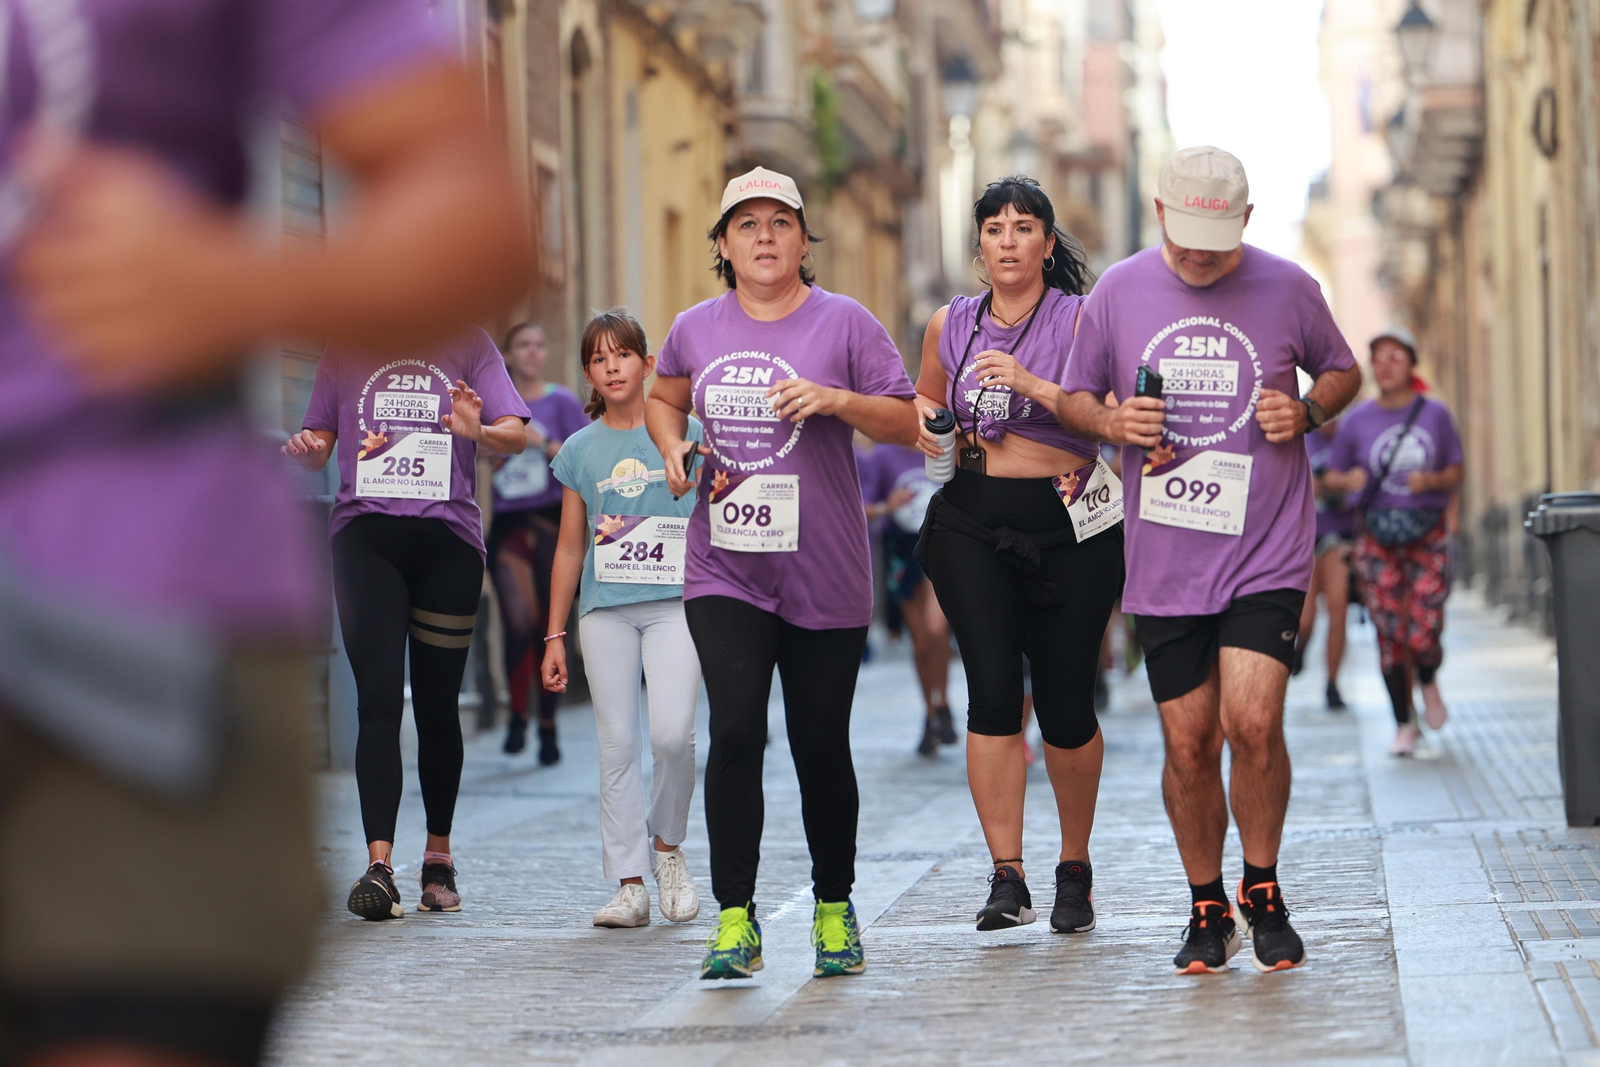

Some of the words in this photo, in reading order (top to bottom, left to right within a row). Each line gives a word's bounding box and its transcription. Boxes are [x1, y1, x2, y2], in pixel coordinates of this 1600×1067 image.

[739, 180, 782, 192] LALIGA
[1184, 195, 1229, 211] LALIGA
[1141, 315, 1221, 362] INTERNACIONAL
[1223, 322, 1258, 361] CONTRA
[1173, 335, 1228, 358] 25N
[361, 359, 427, 395] INTERNACIONAL
[428, 364, 453, 390] CONTR
[694, 350, 771, 390] INTERNACIONAL
[772, 356, 799, 380] CONTR
[721, 365, 774, 385] 25N
[1171, 368, 1183, 378] 24
[1186, 369, 1224, 379] HORAS
[1253, 361, 1263, 378] LA
[387, 374, 432, 391] 25N
[1162, 380, 1187, 390] 900
[1188, 381, 1200, 391] 21
[1202, 381, 1214, 391] 21
[1215, 382, 1232, 392] 30
[384, 399, 394, 407] 24
[396, 399, 429, 409] HORAS
[715, 394, 727, 403] 24
[730, 395, 768, 405] HORAS
[1228, 379, 1263, 433] VIOLENCIA
[376, 408, 397, 417] 900
[398, 409, 408, 418] 21
[409, 410, 419, 419] 21
[420, 411, 434, 419] 30
[707, 405, 731, 415] 900
[733, 406, 744, 416] 21
[747, 407, 758, 417] 21
[760, 407, 775, 418] 30
[388, 425, 415, 433] Ayuntamiento
[721, 424, 753, 434] Ayuntamiento
[1168, 431, 1188, 446] LAS
[1190, 430, 1227, 447] HACIA
[381, 456, 426, 477] 285
[720, 455, 737, 470] LAS
[738, 456, 775, 471] HACIA
[1212, 460, 1246, 470] CARRERA
[396, 478, 410, 486] NO
[410, 479, 443, 488] LASTIMA
[1165, 476, 1222, 504] 099
[1082, 484, 1110, 513] 270
[723, 502, 772, 527] 098
[1149, 498, 1178, 511] ROMPE
[1179, 504, 1188, 512] EL
[1190, 506, 1230, 519] SILENCIO
[1087, 509, 1104, 524] AMOR
[716, 525, 758, 537] TOLERANCIA
[759, 530, 784, 538] CERO
[618, 541, 664, 562] 284
[632, 563, 641, 571] EL
[642, 564, 676, 572] SILENCIO
